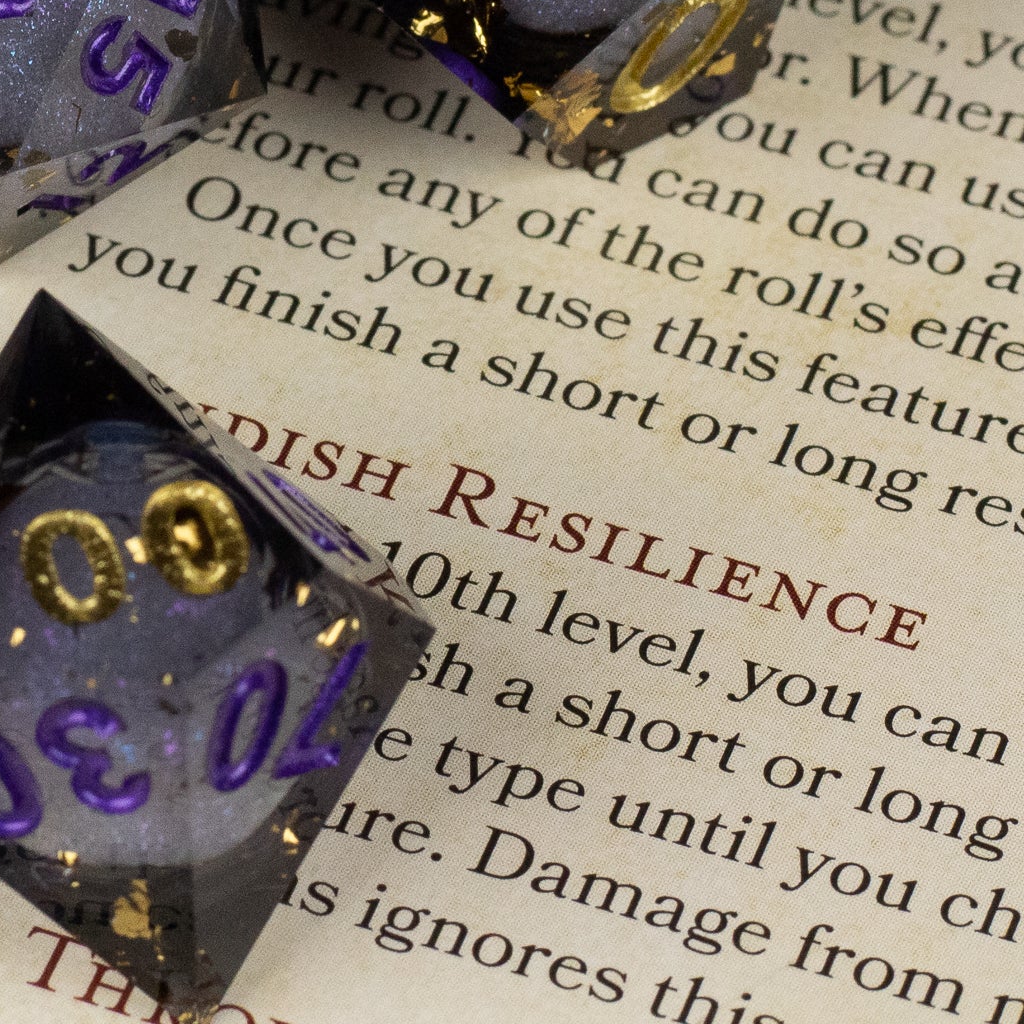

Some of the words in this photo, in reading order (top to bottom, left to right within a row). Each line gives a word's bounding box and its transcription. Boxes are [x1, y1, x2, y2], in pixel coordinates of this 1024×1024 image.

[350, 77, 477, 145] roll.
[818, 137, 940, 196] can
[184, 174, 358, 262] Once
[363, 242, 496, 304] you
[516, 283, 633, 342] use
[652, 315, 781, 384] this
[377, 165, 504, 230] any
[516, 206, 596, 250] of
[598, 222, 706, 283] the
[722, 264, 890, 334] roll's
[646, 165, 768, 226] can
[786, 198, 871, 252] do
[887, 231, 967, 276] so
[66, 231, 200, 295] you
[212, 263, 404, 358] finish
[421, 336, 462, 375] a
[479, 350, 666, 431] short
[680, 410, 759, 455] or
[767, 422, 929, 514] long
[196, 401, 413, 502] DISH
[427, 461, 930, 652] RESILIENCE
[534, 589, 712, 689] level,
[726, 657, 865, 724] you
[883, 702, 1012, 768] can
[433, 734, 589, 814] type
[607, 792, 779, 871] until
[778, 844, 920, 914] you
[493, 674, 537, 716] a
[554, 687, 749, 776] short
[762, 753, 844, 801] or
[853, 764, 1021, 864] long
[353, 882, 629, 1004] ignores
[465, 823, 773, 957] Damage
[787, 922, 966, 1017] from
